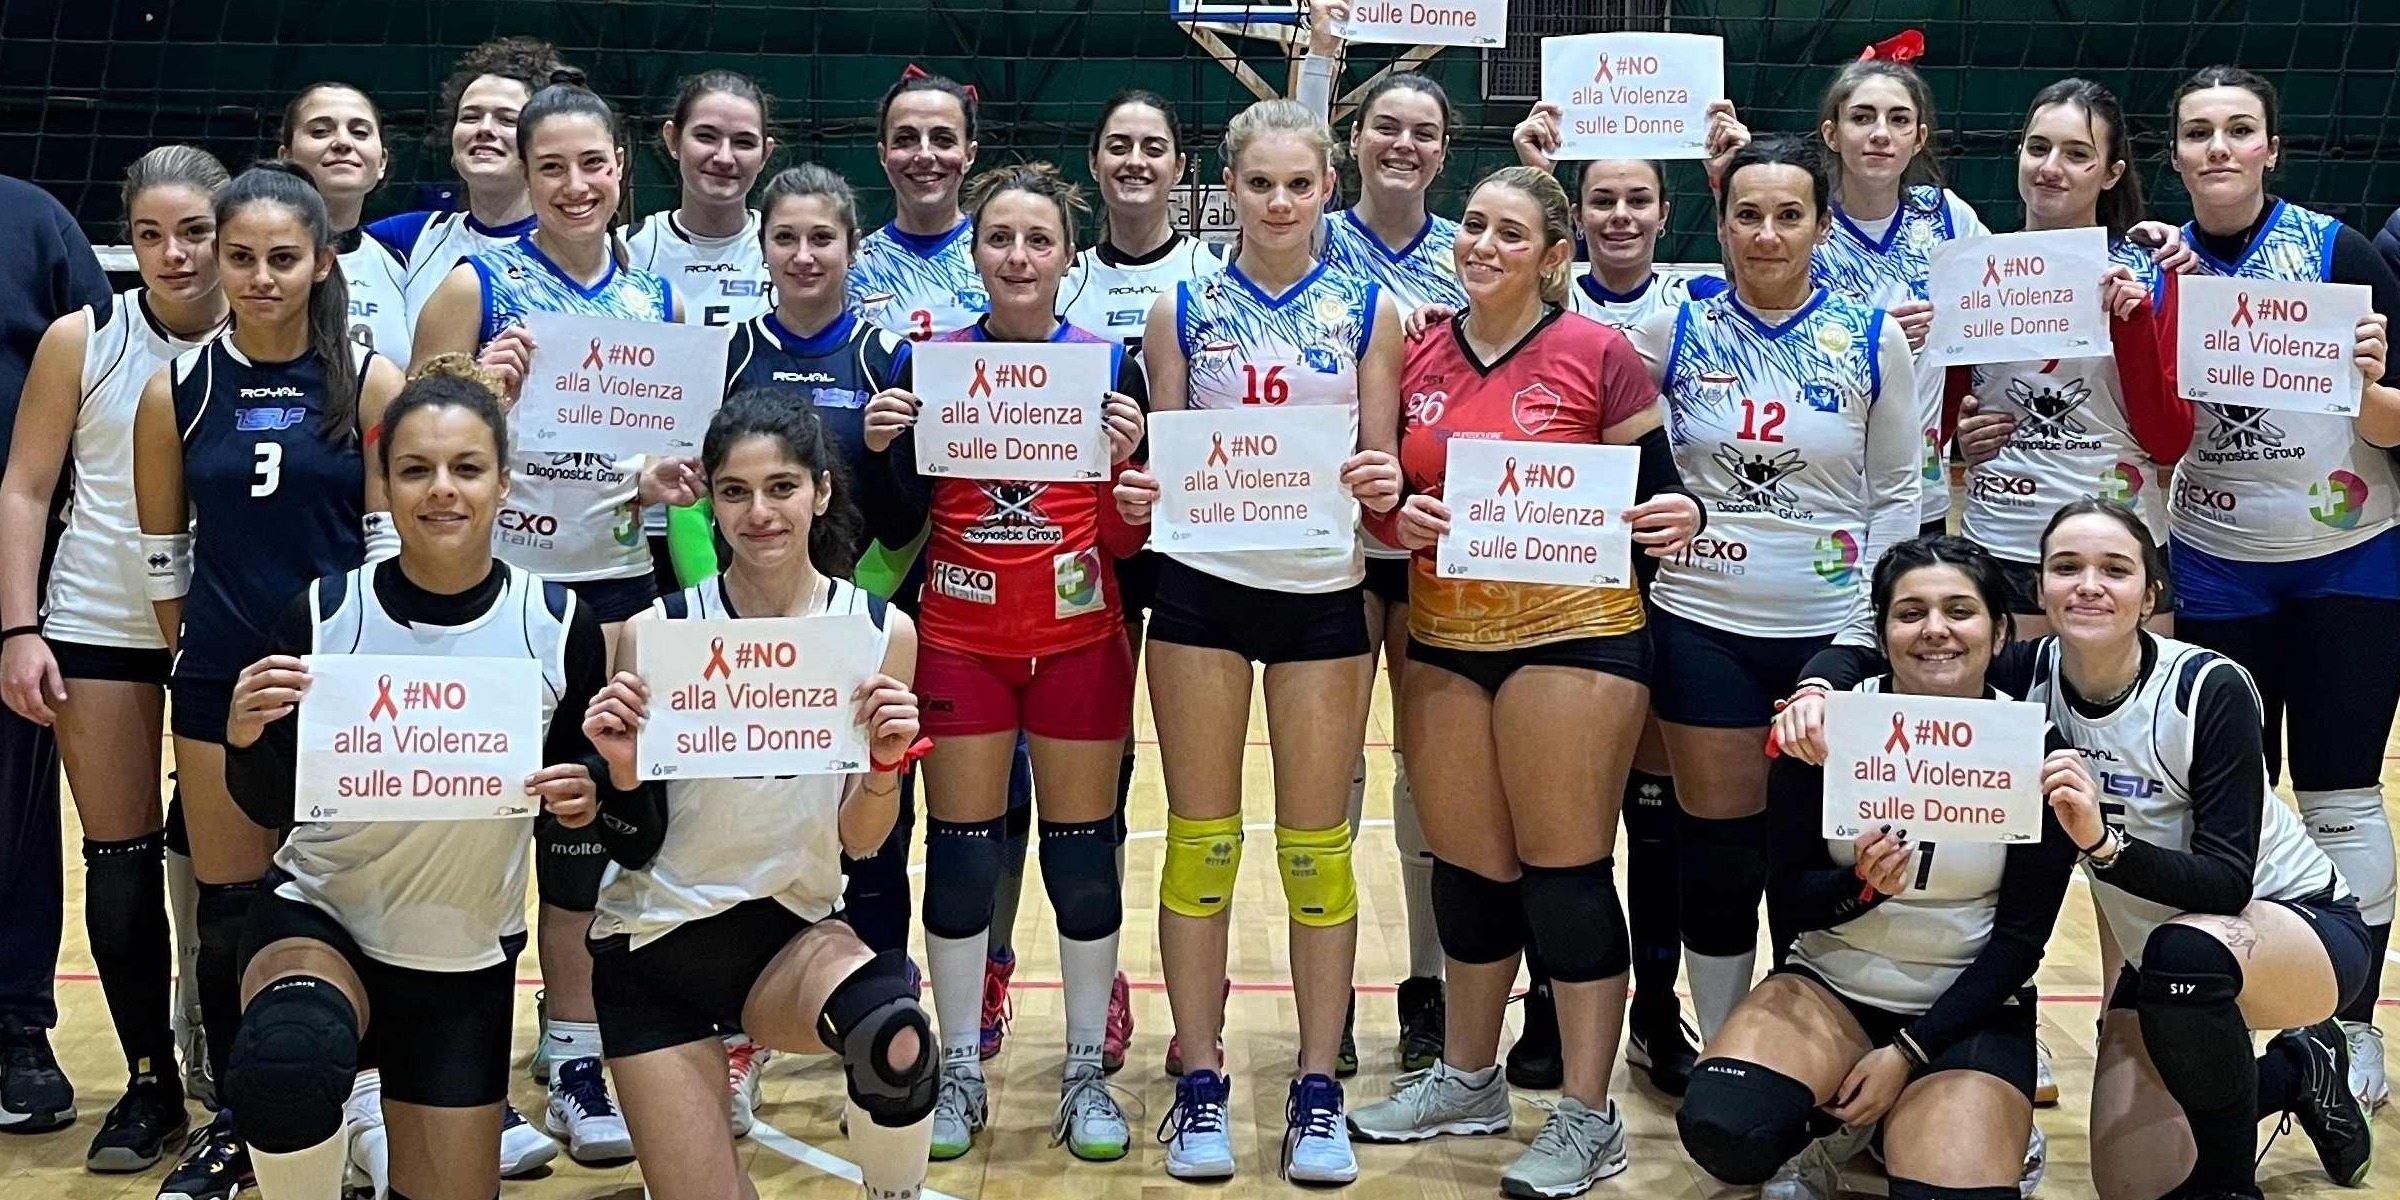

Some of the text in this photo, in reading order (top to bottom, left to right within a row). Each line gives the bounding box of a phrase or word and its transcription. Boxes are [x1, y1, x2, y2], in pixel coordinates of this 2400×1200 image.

[1357, 2, 1476, 26] sulle Donne
[1617, 56, 1657, 75] #NO
[1572, 86, 1687, 105] alla Violenza
[1576, 116, 1684, 134] sulle Donne
[2004, 257, 2044, 277] #NO
[1961, 284, 2073, 309] alla Violenza
[2258, 299, 2307, 322] #NO
[909, 309, 932, 342] 3
[1964, 317, 2069, 338] sulle Donne
[2204, 326, 2339, 359] alla Violenza
[609, 345, 654, 367] #NO
[556, 373, 682, 400] alla Violenza
[996, 365, 1047, 388] #NO
[1242, 364, 1289, 405] 16
[2207, 365, 2332, 393] sulle Donne
[558, 404, 674, 430] sulle Donne
[942, 401, 1082, 424] alla Violenza
[1736, 399, 1786, 443] 12
[948, 438, 1077, 460] sulle Donne
[1232, 435, 1277, 457] #NO
[2064, 440, 2102, 450] Group
[2198, 446, 2306, 465] Diagnostic Group
[251, 442, 283, 497] 3
[526, 463, 625, 484] Diagnostic Group
[1185, 469, 1310, 491] alla Violenza
[1525, 464, 1574, 489] #NO
[1190, 501, 1307, 523] sulle Donne
[1470, 499, 1604, 526] alla Violenza
[1026, 528, 1062, 542] Group
[1469, 536, 1596, 563] sulle Donne
[736, 642, 796, 668] #NO
[404, 682, 465, 709] #NO
[672, 683, 837, 710] alla Violenza
[335, 726, 508, 753] alla Violenza
[678, 725, 831, 753] sulle Donne
[1915, 720, 1972, 747] #NO
[338, 770, 502, 797] sulle Donne
[1855, 753, 2011, 789] alla Violenza
[1859, 797, 2005, 824] sulle Donne
[551, 840, 606, 855] molte
